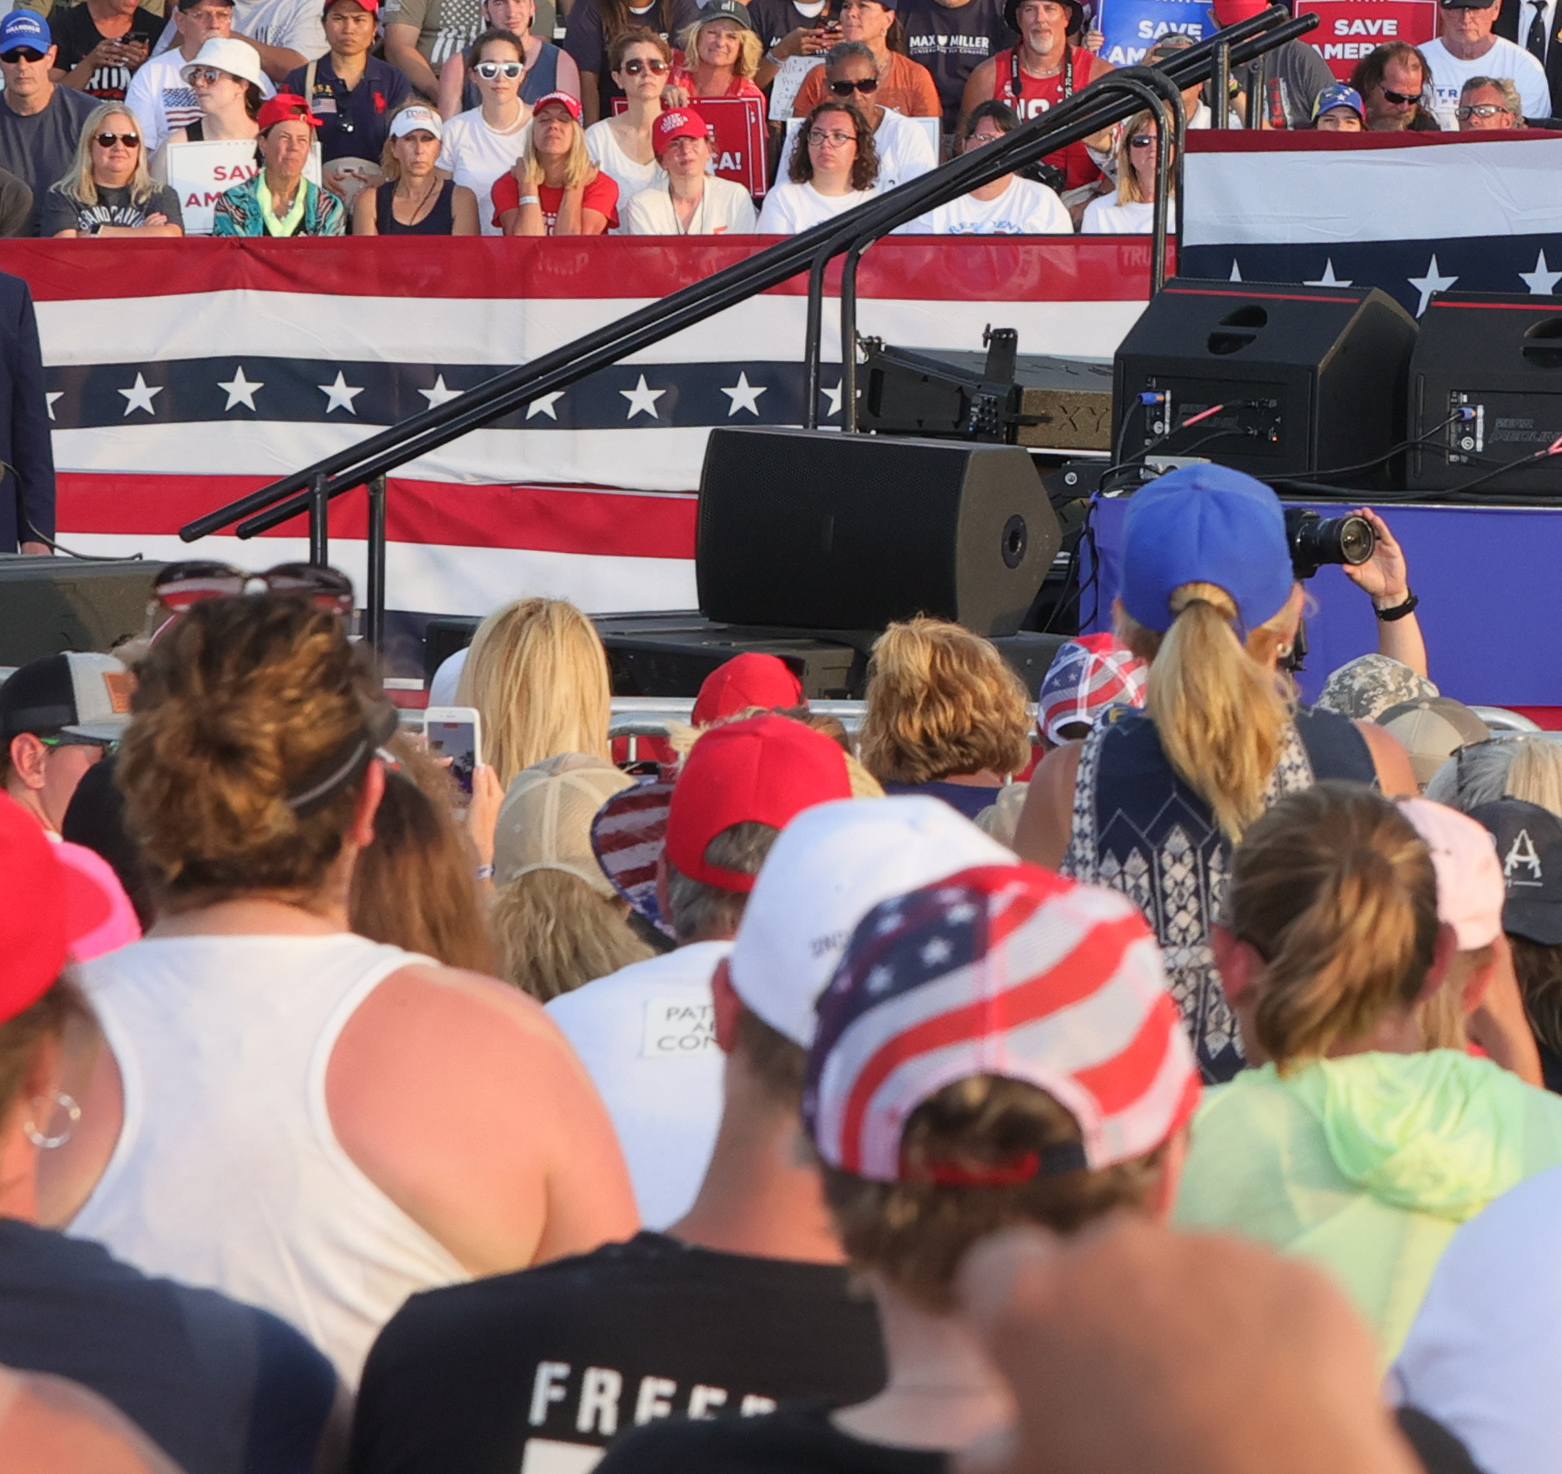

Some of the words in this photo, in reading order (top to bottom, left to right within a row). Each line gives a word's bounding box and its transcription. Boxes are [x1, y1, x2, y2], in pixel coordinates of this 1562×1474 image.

[1138, 20, 1203, 41] SAVE
[1334, 19, 1398, 36] SAVE
[910, 36, 936, 49] MAX
[949, 35, 990, 49] MILLER
